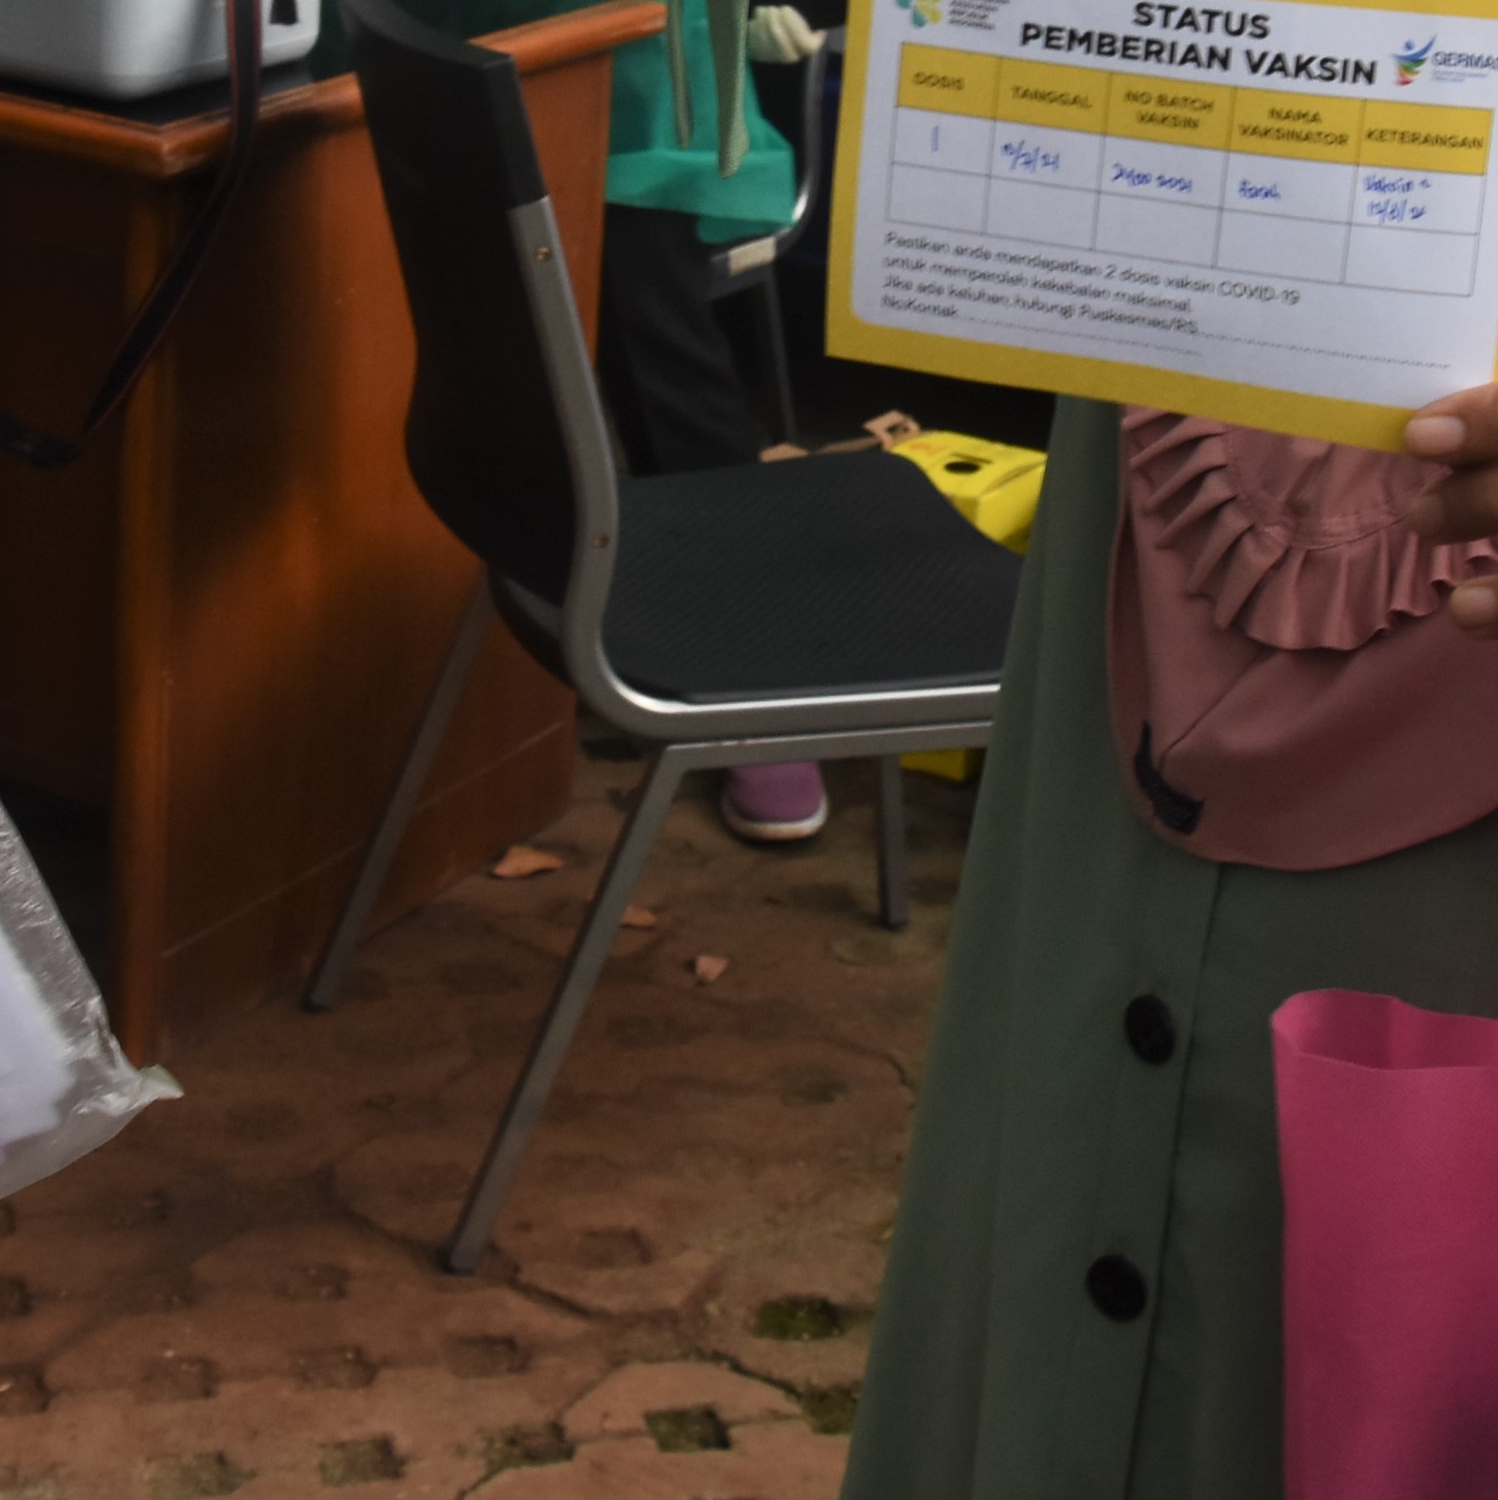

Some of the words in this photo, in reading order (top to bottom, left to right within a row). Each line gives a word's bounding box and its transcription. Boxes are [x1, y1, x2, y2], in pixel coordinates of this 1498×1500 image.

[1132, 1, 1272, 40] STATUS
[1020, 22, 1233, 73] PEMBERIAN
[1245, 48, 1378, 86] VAKSIN
[912, 71, 965, 91] DOSIS
[1011, 84, 1093, 108] TANGGAL
[1124, 90, 1153, 104] NO
[1156, 95, 1215, 112] BATCH
[1136, 113, 1200, 130] VAKSIN
[1268, 107, 1322, 124] NAMA
[1238, 123, 1350, 147] VAKSINATOR
[1364, 127, 1485, 149] KETERANGAN
[1104, 264, 1118, 280] 2
